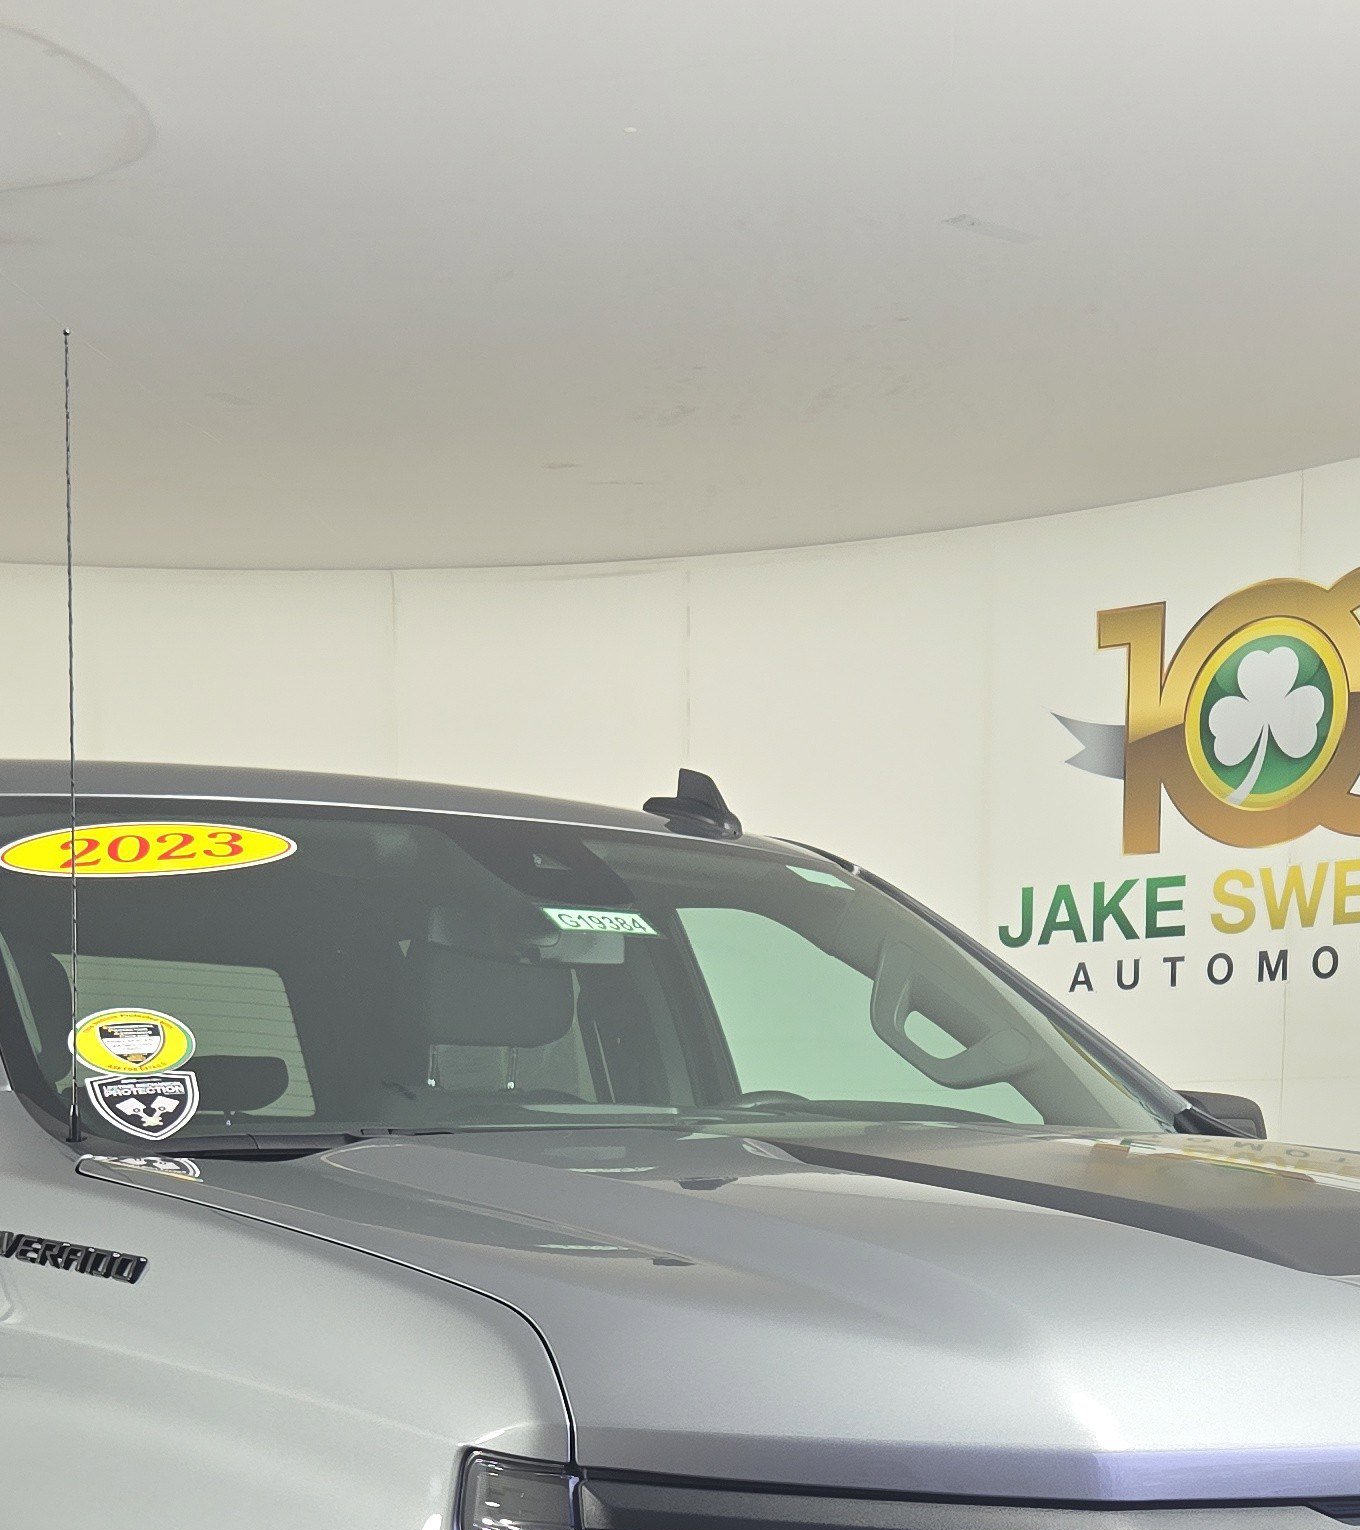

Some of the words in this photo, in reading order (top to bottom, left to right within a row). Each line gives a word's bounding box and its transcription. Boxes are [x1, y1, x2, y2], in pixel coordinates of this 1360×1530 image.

[60, 831, 244, 869] 2023
[557, 913, 647, 933] G19384
[998, 875, 1187, 948] JAKE
